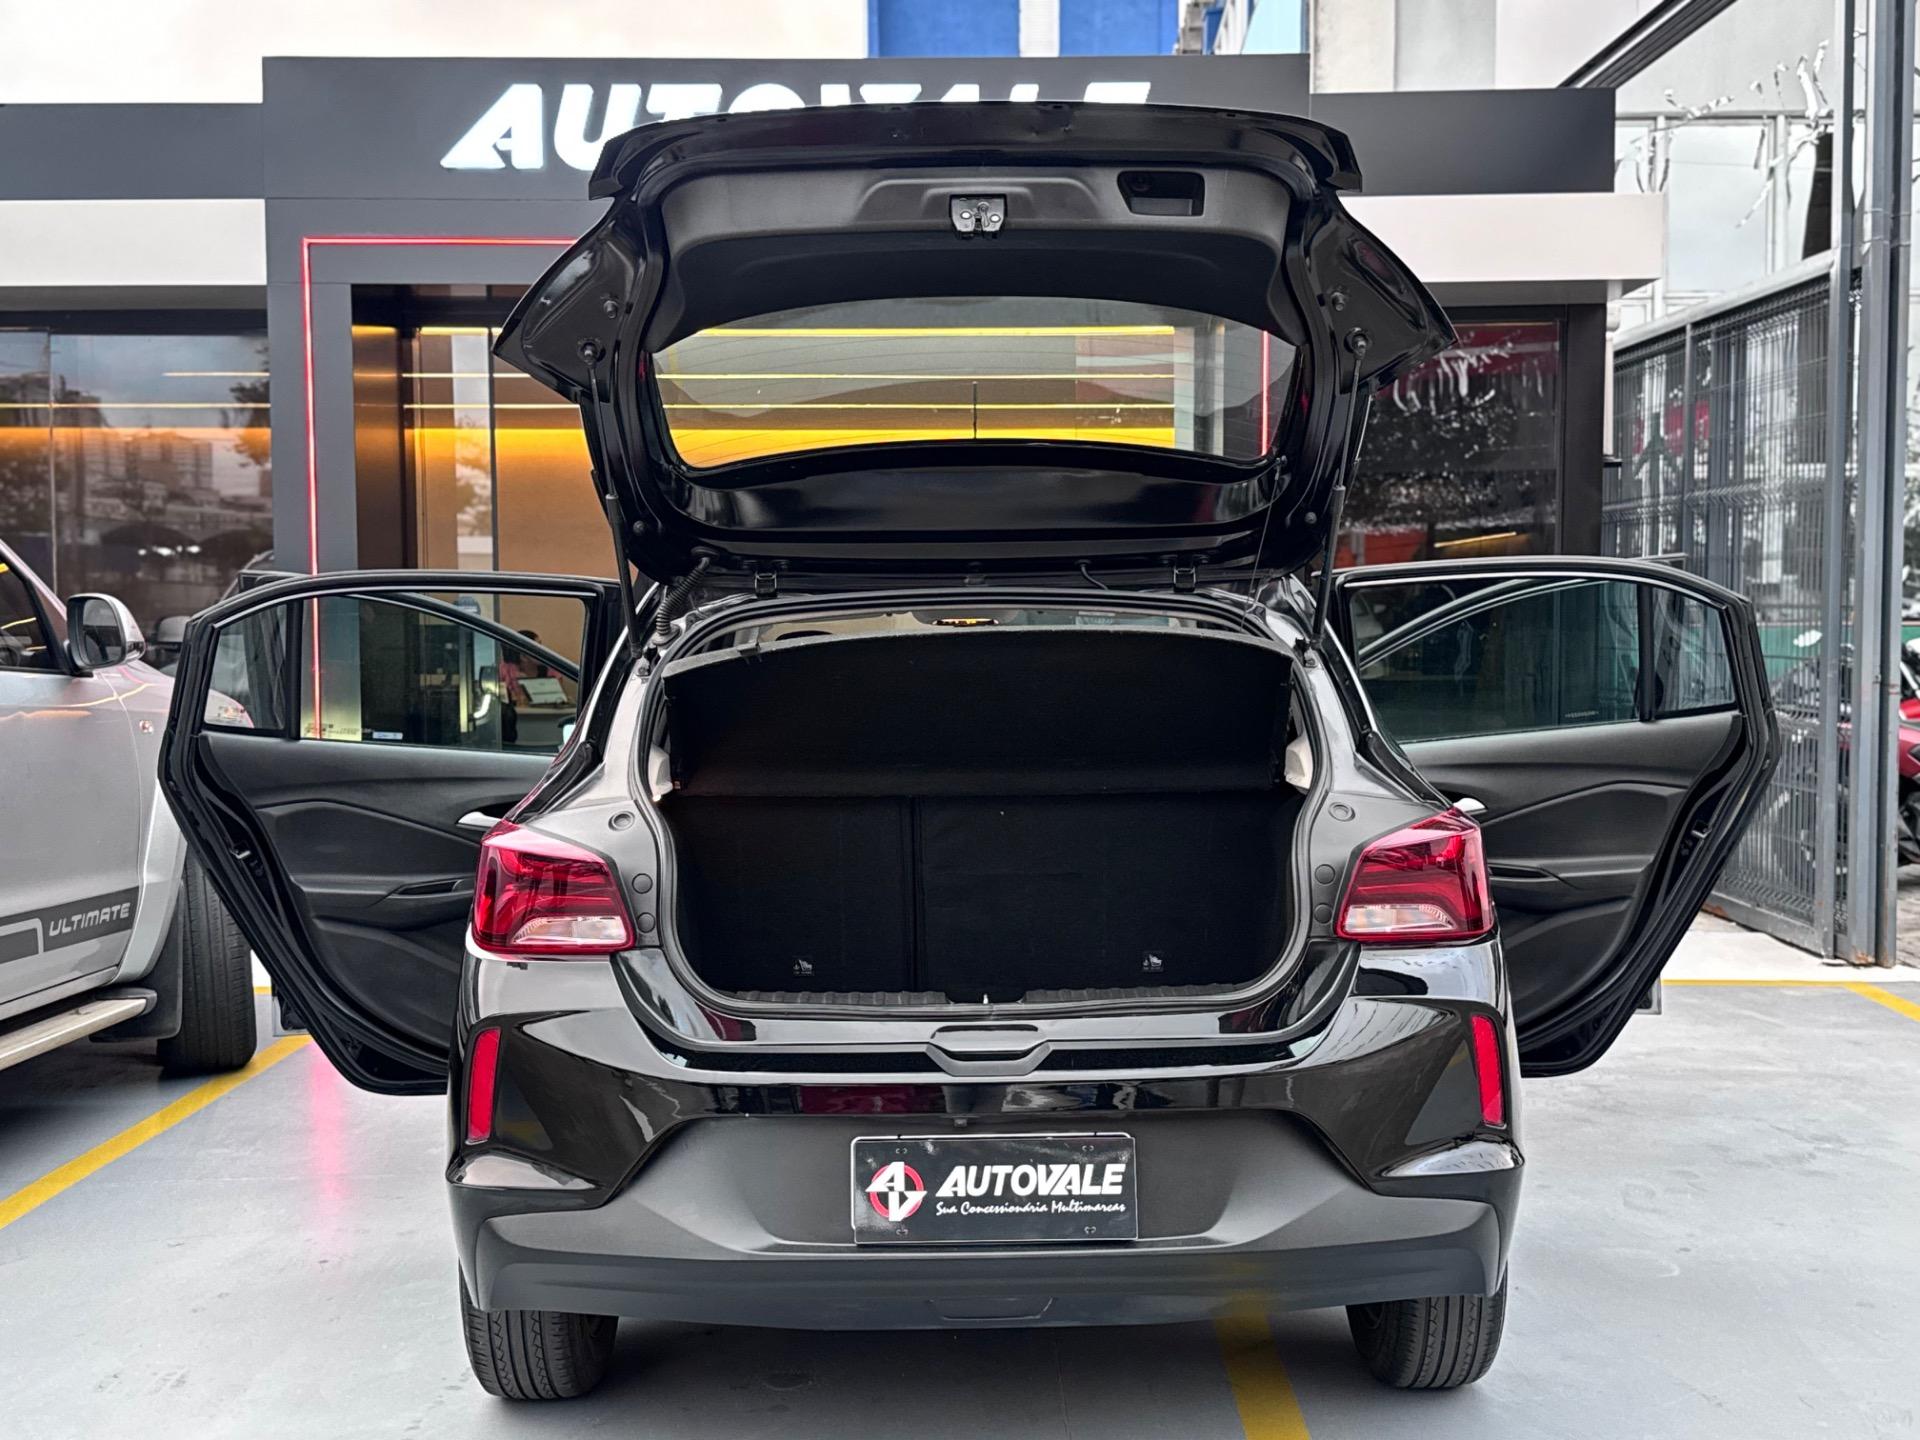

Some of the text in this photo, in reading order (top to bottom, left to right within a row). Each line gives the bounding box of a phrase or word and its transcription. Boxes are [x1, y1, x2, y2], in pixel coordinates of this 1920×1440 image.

[48, 902, 131, 937] ULTIMATE
[935, 1163, 1126, 1197] AUTOVALE
[935, 1201, 958, 1216] Sua
[1051, 1199, 1126, 1214] Multimarcas
